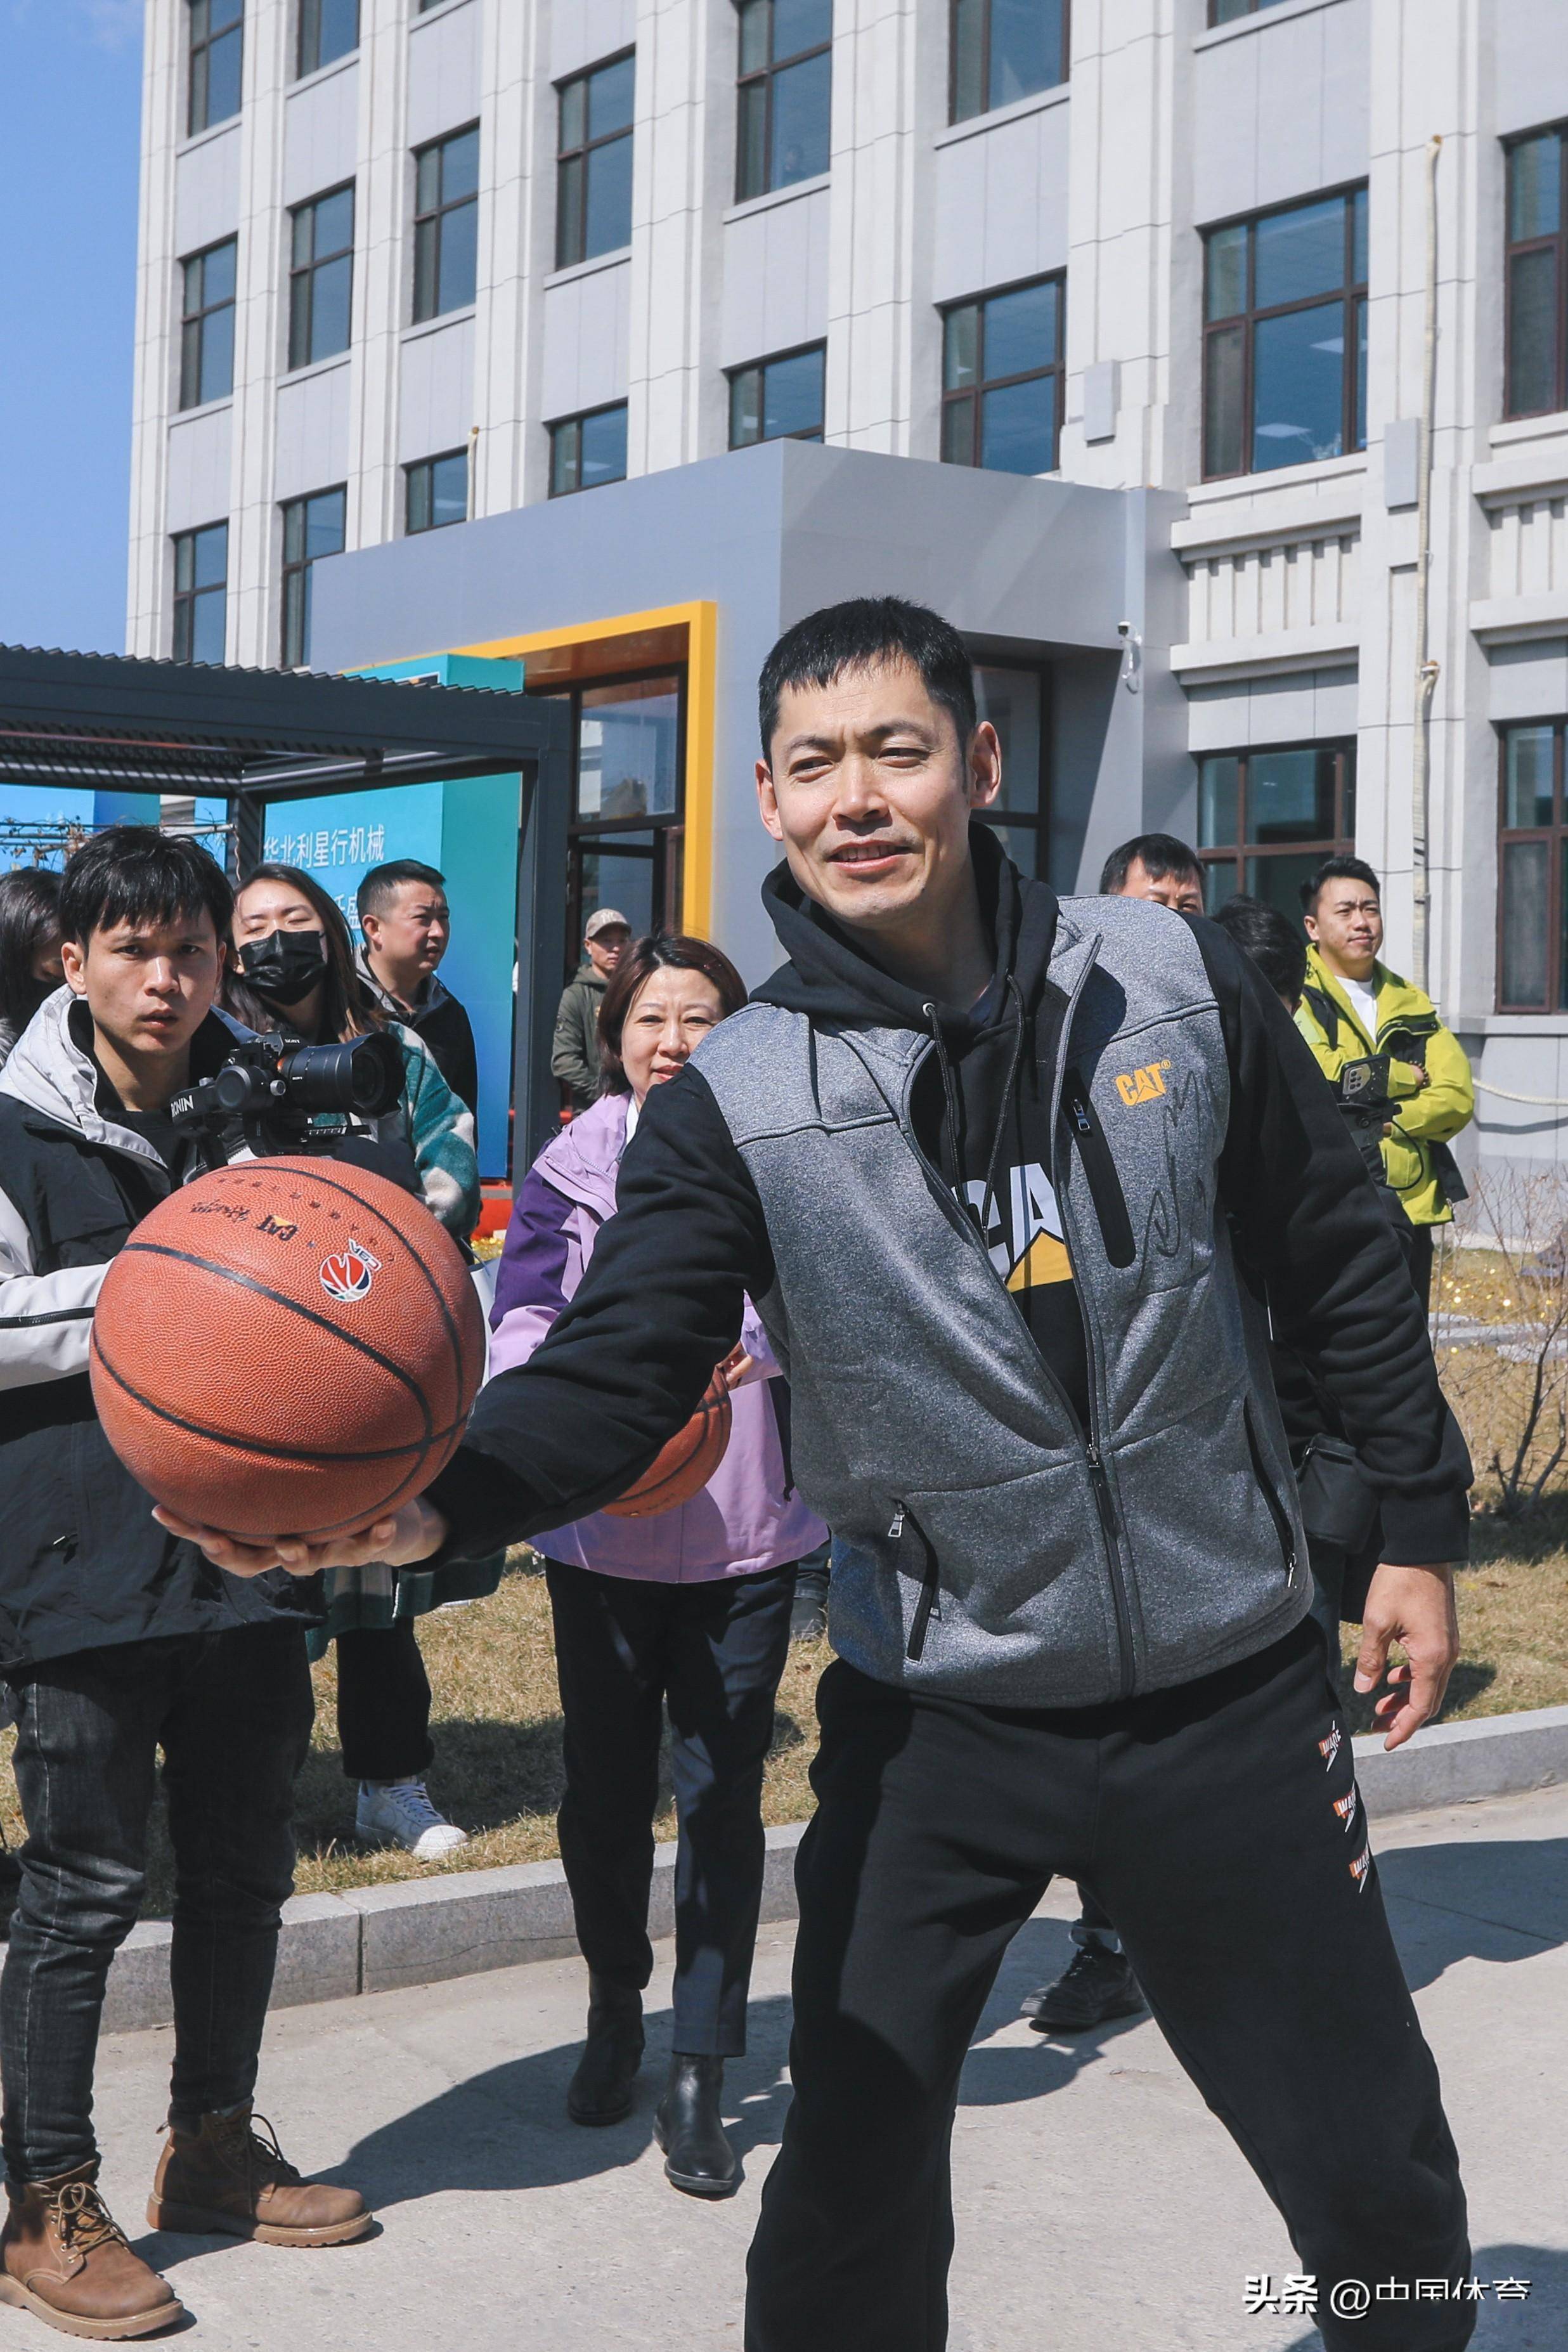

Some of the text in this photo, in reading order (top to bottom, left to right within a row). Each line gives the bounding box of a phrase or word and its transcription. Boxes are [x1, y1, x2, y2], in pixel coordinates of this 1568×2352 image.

[263, 824, 385, 869] 华北利星行机械
[256, 1214, 298, 1242] CAT
[951, 1162, 1072, 1289] CA
